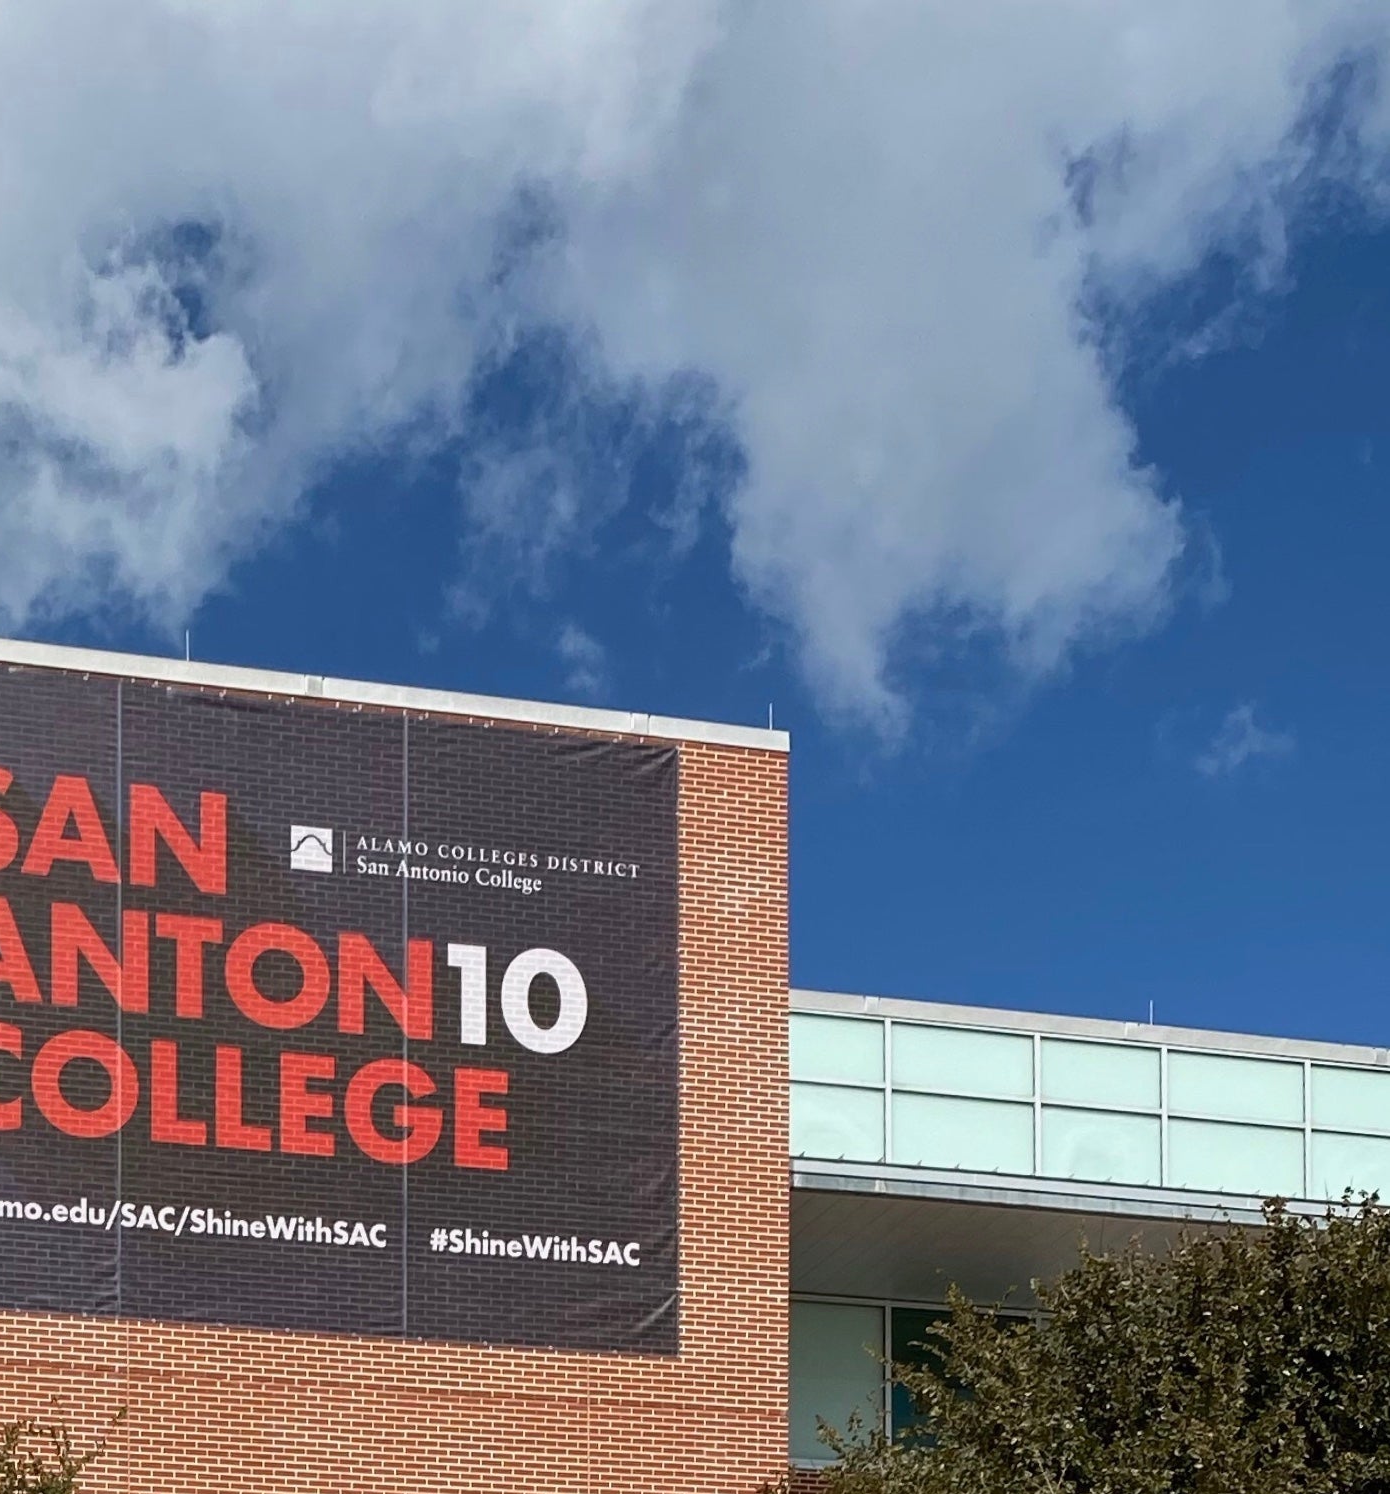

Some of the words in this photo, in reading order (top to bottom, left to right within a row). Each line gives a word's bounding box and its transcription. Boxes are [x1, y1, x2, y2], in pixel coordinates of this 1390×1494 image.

[356, 835, 430, 859] ALAMO
[437, 842, 540, 869] COLLEGES
[547, 854, 641, 880] DISTRICT
[356, 854, 391, 879] San
[395, 858, 470, 886] Antonio
[475, 864, 543, 895] College
[429, 1227, 641, 1269] #ShineWithSAC
